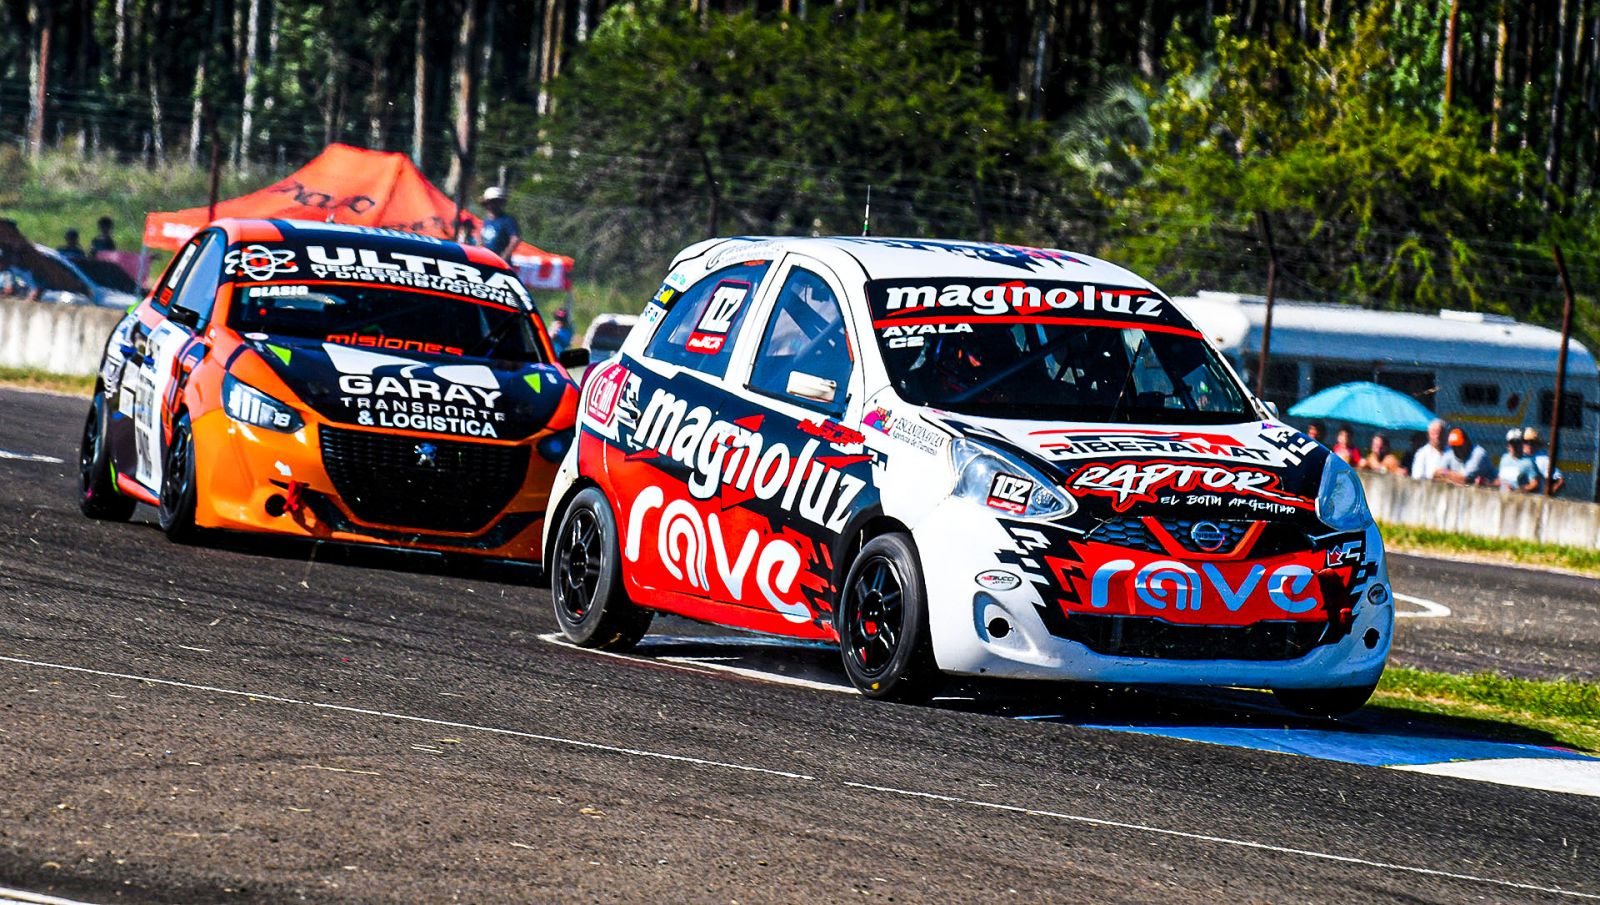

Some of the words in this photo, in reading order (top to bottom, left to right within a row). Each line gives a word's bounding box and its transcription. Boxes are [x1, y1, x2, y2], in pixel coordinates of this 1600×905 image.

[306, 245, 528, 299] ULTRA
[312, 271, 327, 279] Y
[698, 286, 747, 333] 102
[886, 283, 1162, 317] magnoluz
[327, 333, 463, 356] misiones
[883, 322, 973, 336] AYALA
[339, 375, 502, 408] GARAY
[341, 397, 505, 422] TRANSPORTE
[357, 411, 374, 425] &
[379, 411, 498, 438] LOGISTICA
[634, 388, 867, 534] magnoluz
[1040, 438, 1272, 461] RIBERAMAT
[991, 475, 1033, 504] 102
[1074, 463, 1304, 503] RAPTOR
[1160, 495, 1181, 505] EL
[1229, 496, 1296, 515] ARGENTINO
[625, 486, 813, 623] rave
[1091, 559, 1317, 611] rave
